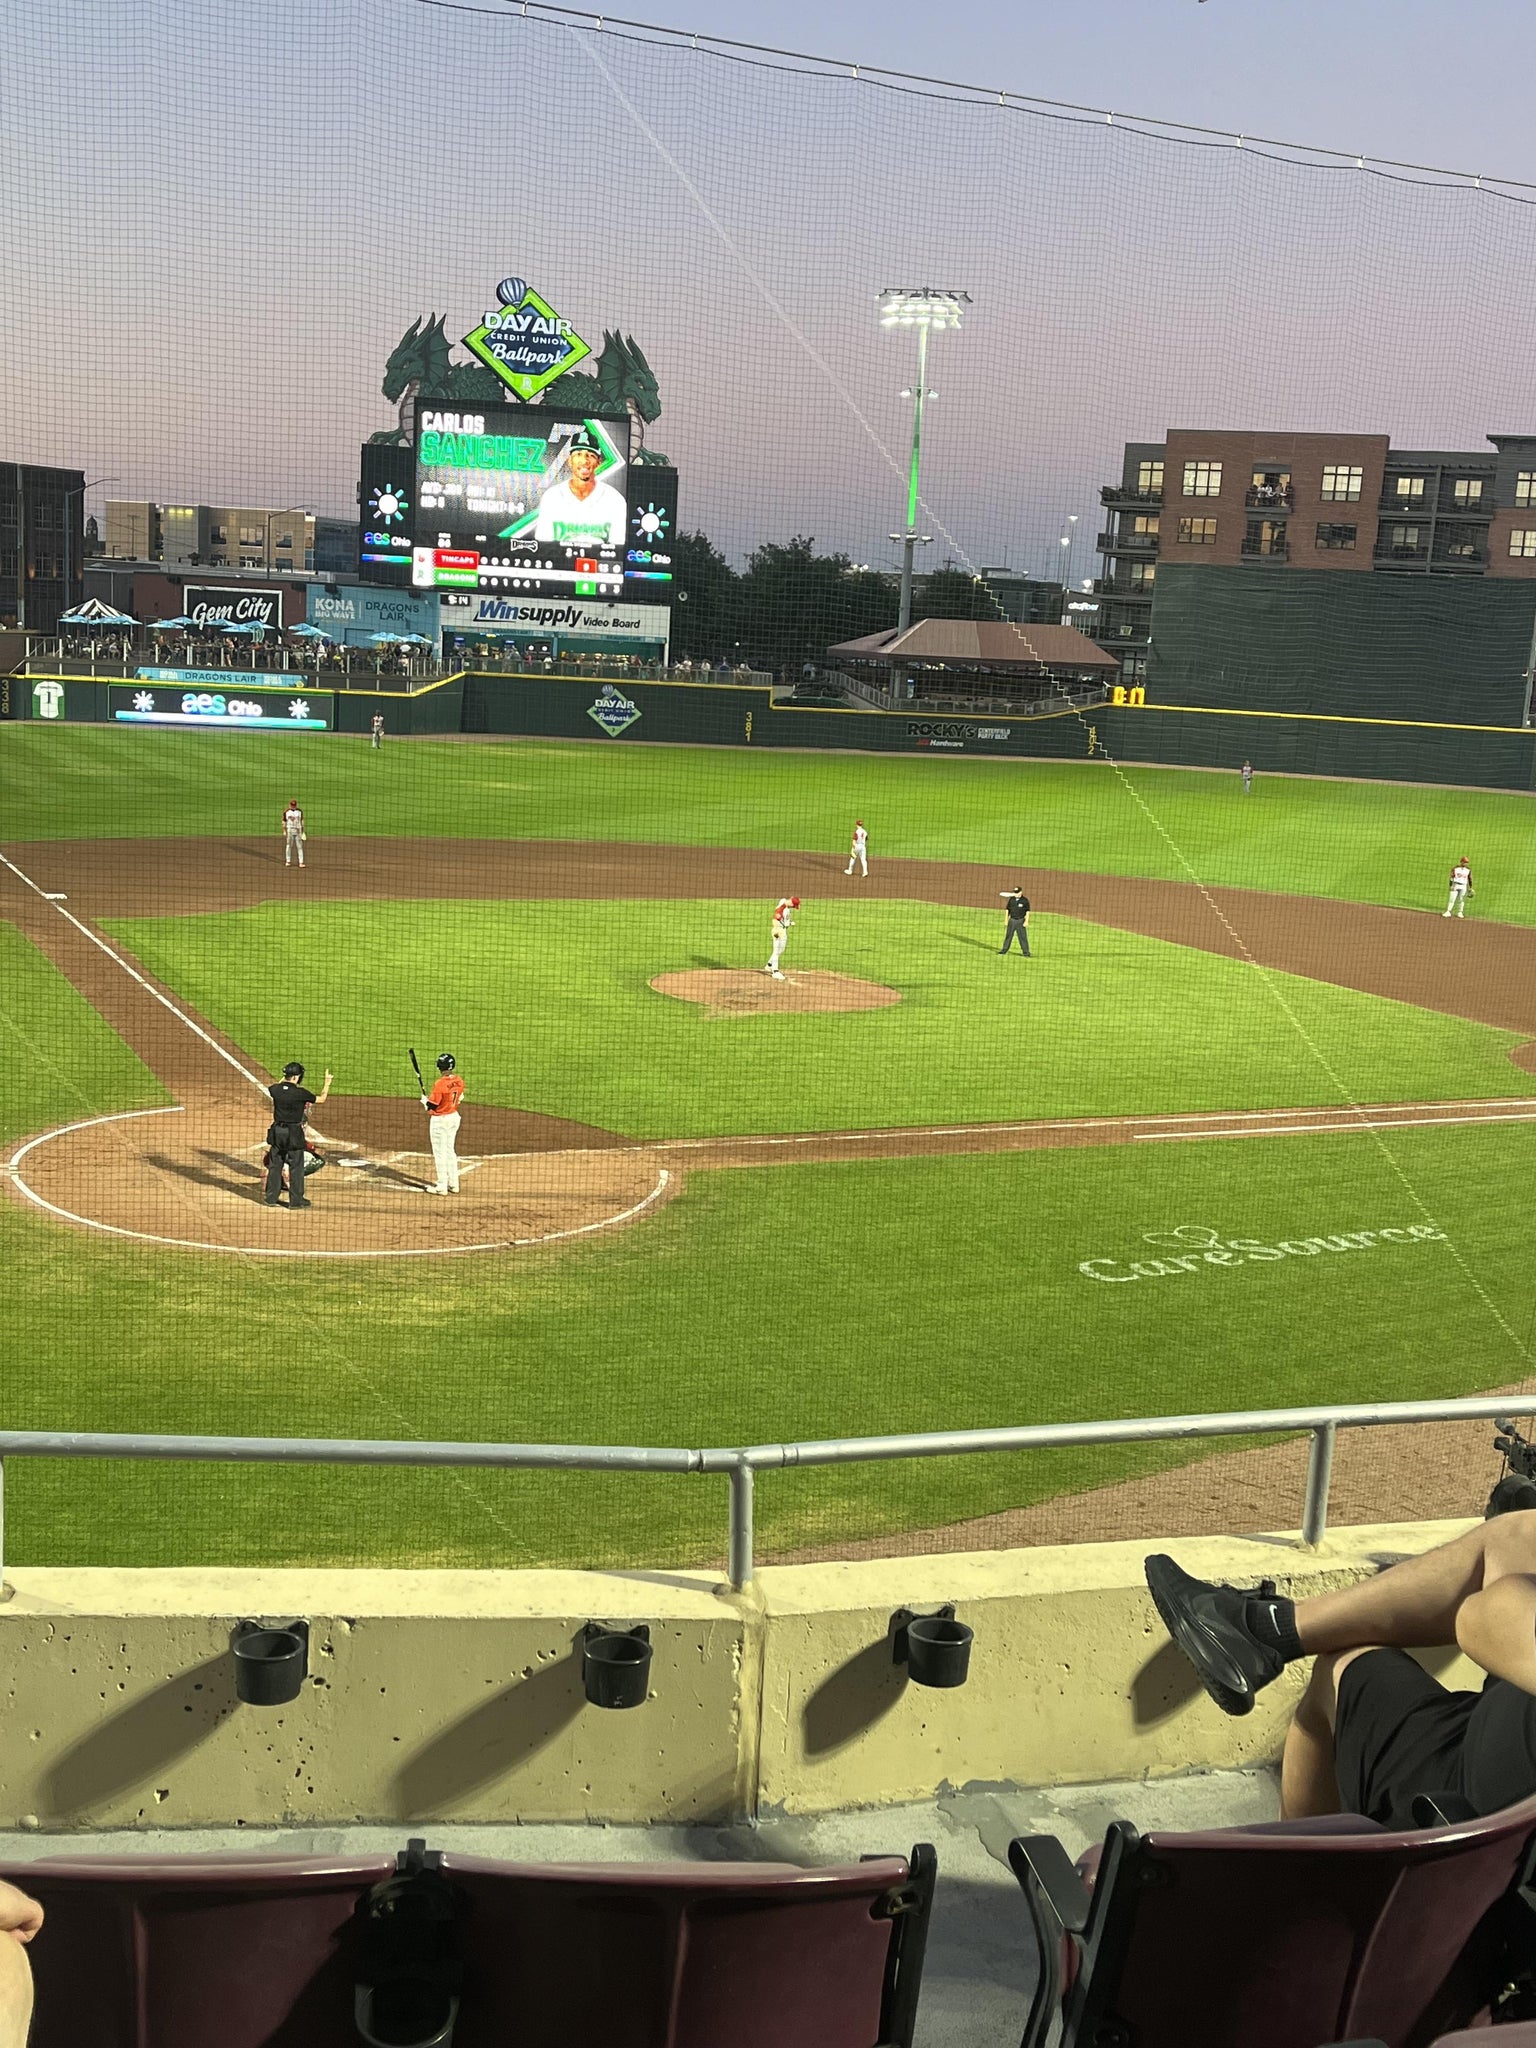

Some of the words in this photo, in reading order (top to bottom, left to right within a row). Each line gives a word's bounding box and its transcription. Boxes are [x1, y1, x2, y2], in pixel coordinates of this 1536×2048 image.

[484, 311, 532, 331] DAY
[531, 317, 573, 336] AIR
[490, 333, 526, 342] CREDIT
[532, 337, 567, 345] UNION
[491, 343, 564, 366] Ballpark
[421, 411, 485, 434] CARLOS
[420, 431, 547, 474] SANCHEZ
[364, 531, 390, 545] aes
[391, 536, 411, 547] Ohio
[627, 549, 651, 563] aes
[652, 553, 671, 564] Ohio
[315, 597, 355, 611] KONA
[365, 601, 420, 613] DRAGONS
[192, 602, 234, 631] Gem
[236, 596, 273, 624] City
[332, 611, 355, 619] WAVE
[379, 611, 405, 621] LAIR
[478, 600, 582, 628] Winsupply
[583, 617, 609, 627] Video
[612, 619, 640, 629] Board
[185, 671, 231, 682] DRAGONS
[235, 674, 257, 683] LAIR
[181, 693, 226, 715] aes
[228, 700, 263, 717] Ohio
[595, 699, 616, 708] DAY
[616, 701, 635, 709] AIR
[930, 739, 964, 747] Hardware
[1078, 1224, 1448, 1283] CareSource
